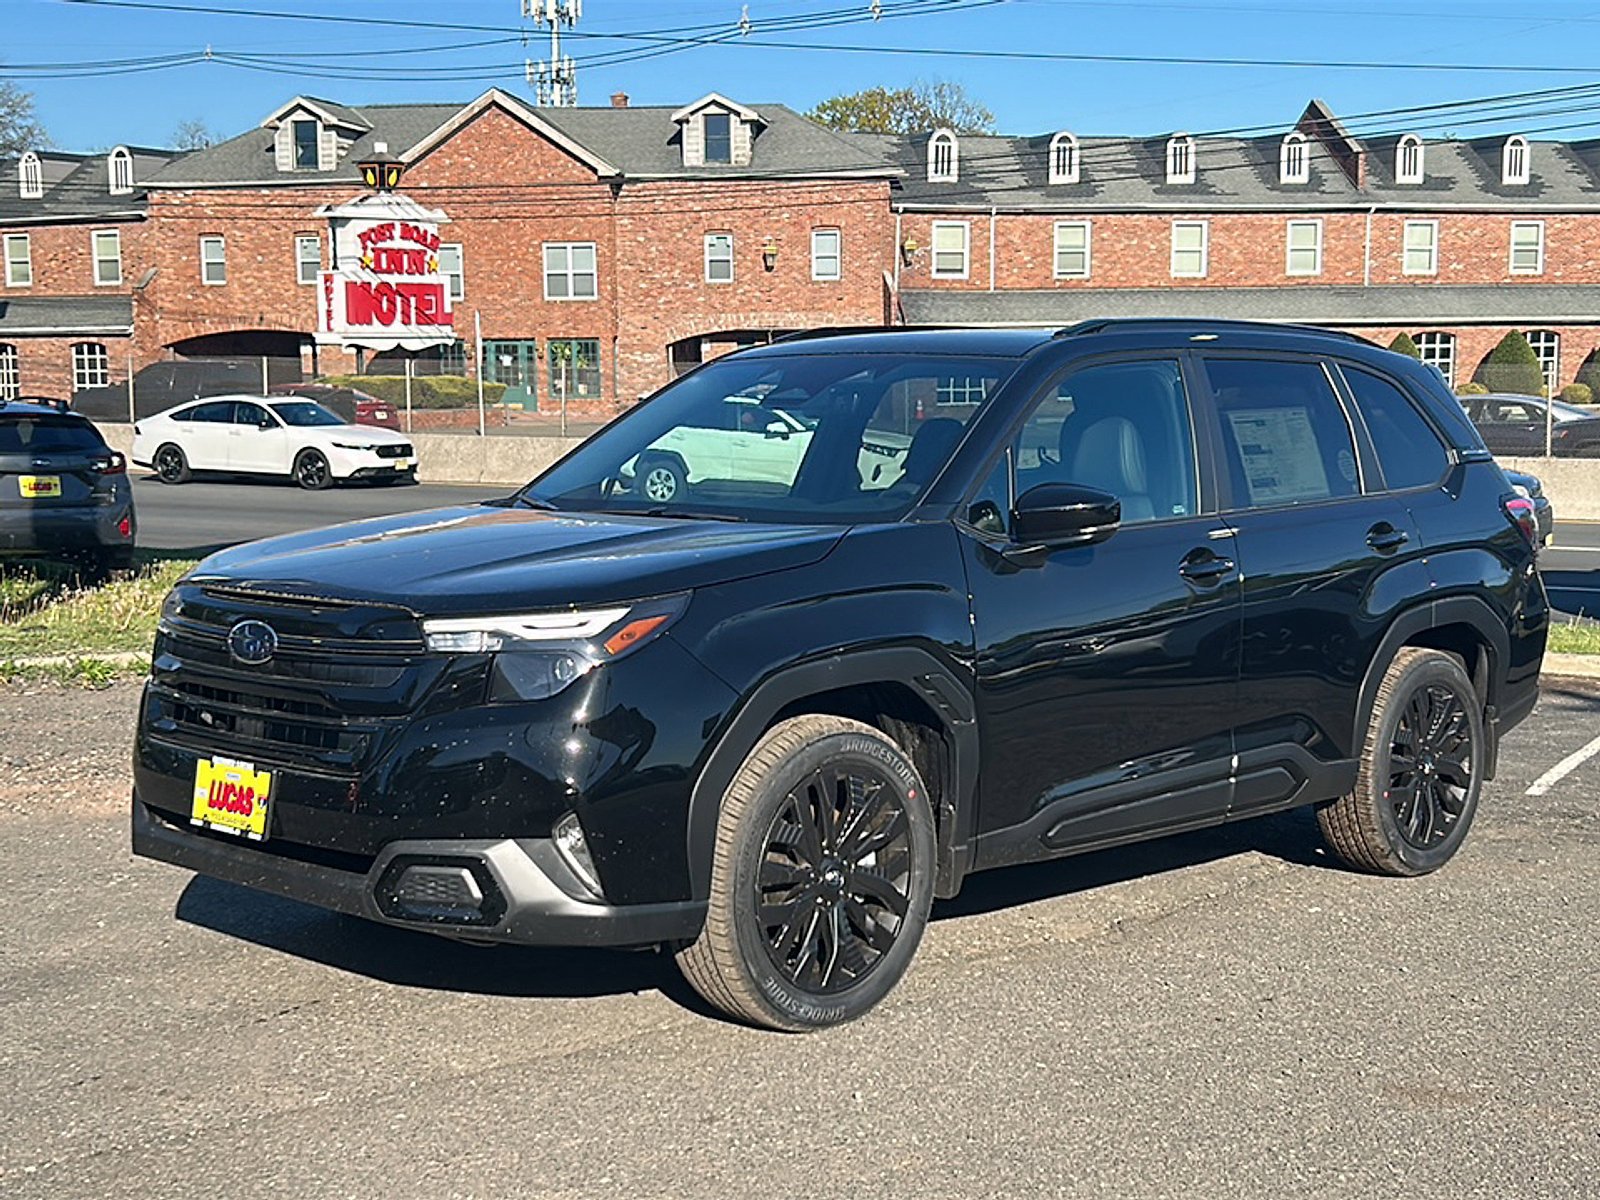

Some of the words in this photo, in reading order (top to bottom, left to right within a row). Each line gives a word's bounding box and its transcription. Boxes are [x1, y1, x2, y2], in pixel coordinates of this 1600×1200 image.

[357, 222, 395, 251] POST
[371, 247, 428, 275] INN
[345, 280, 454, 326] MOTEL
[840, 738, 917, 788] BRIDGESTONE
[208, 778, 255, 817] LUCAS
